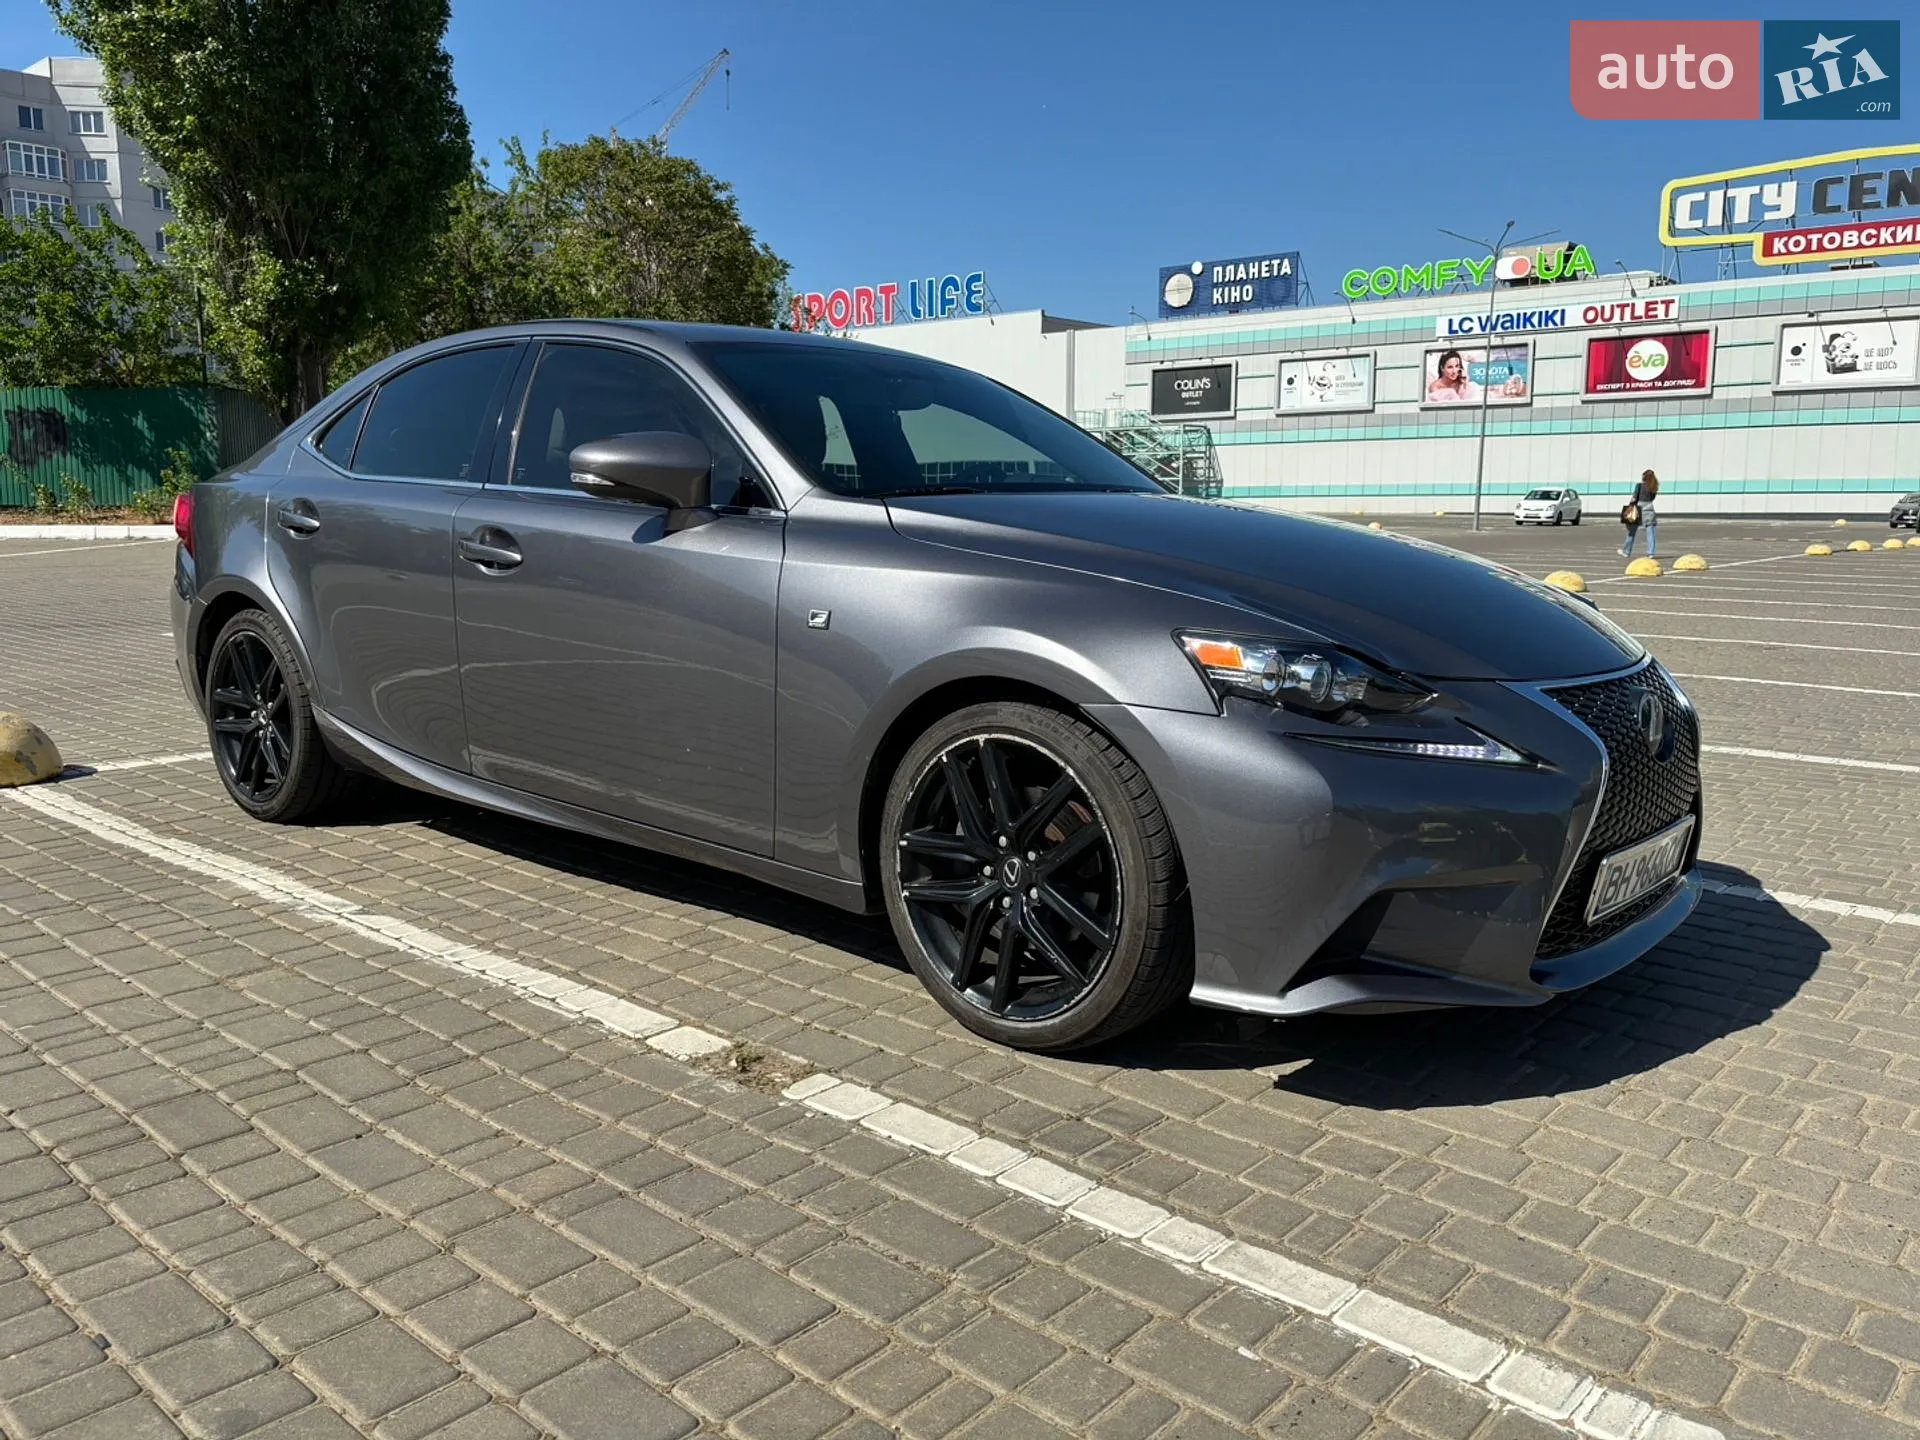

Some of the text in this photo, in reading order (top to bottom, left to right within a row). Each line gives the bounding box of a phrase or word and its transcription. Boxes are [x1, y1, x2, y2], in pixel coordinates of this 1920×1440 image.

[1675, 180, 1798, 230] CITY
[1772, 223, 1920, 255] КОТОВСКИ
[1213, 258, 1292, 284] ПЛАНЕТА
[1342, 244, 1595, 299] COMFY UA
[792, 270, 984, 332] SPORT LIFE
[1213, 285, 1253, 305] КІНО
[1582, 299, 1676, 325] OUTLET
[1174, 377, 1211, 391] COLIN'S
[1472, 366, 1509, 376] ЗООТА
[1181, 390, 1203, 398] OUTLET
